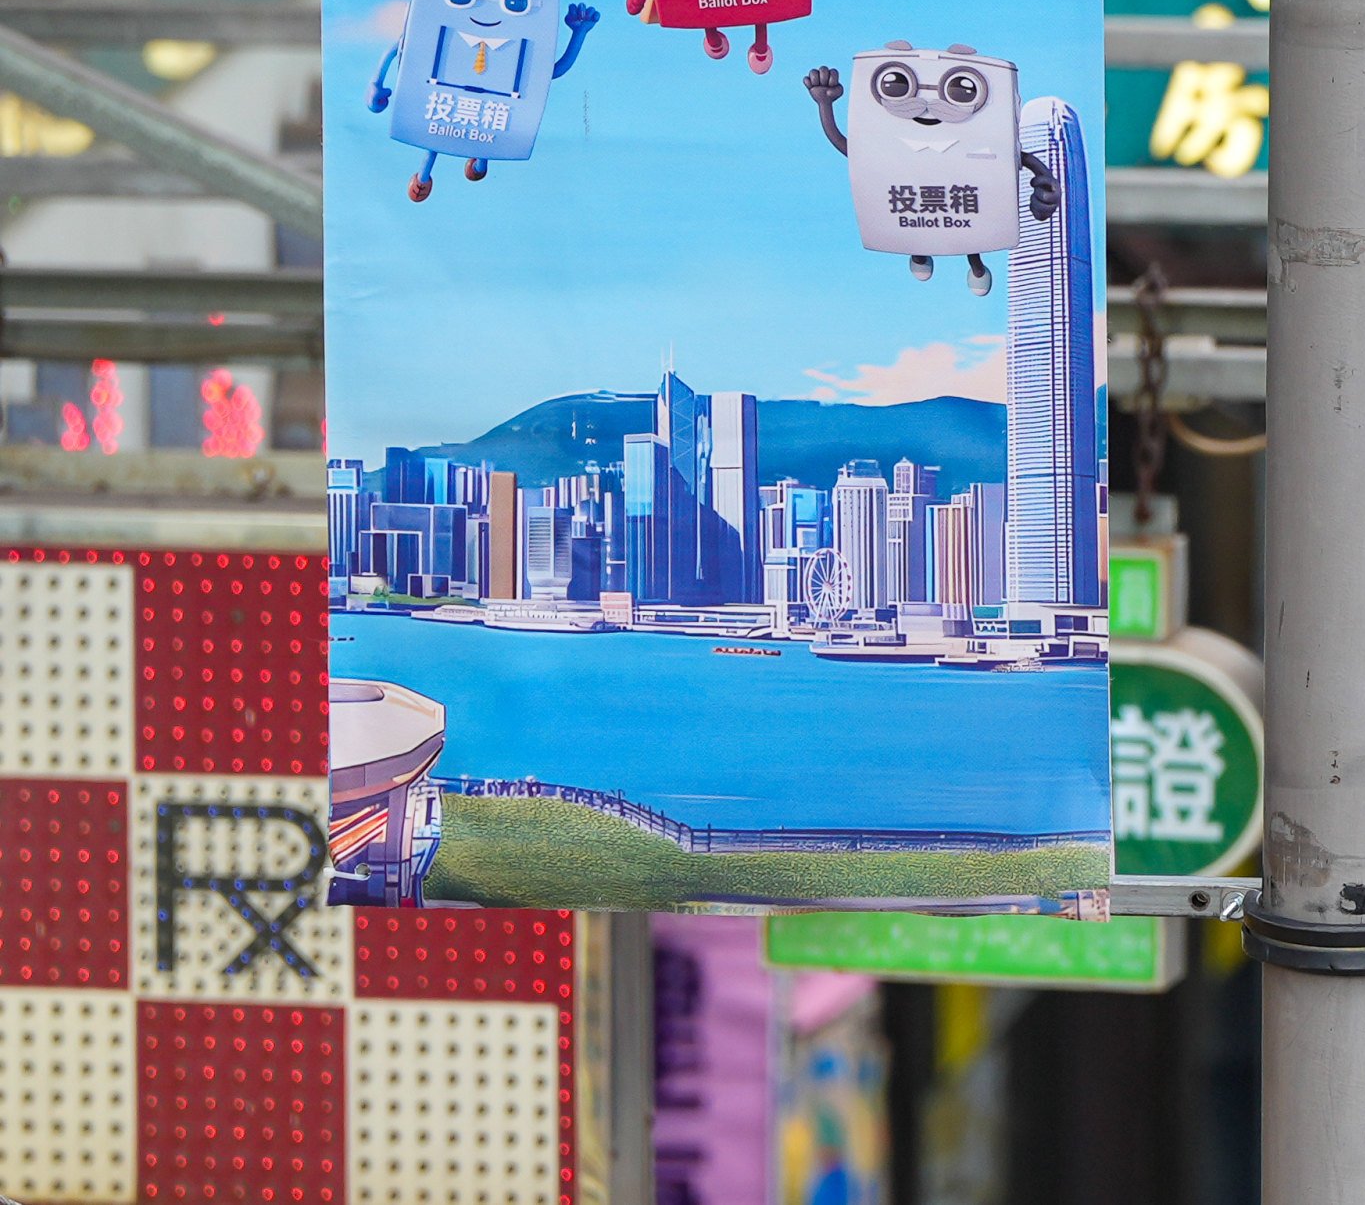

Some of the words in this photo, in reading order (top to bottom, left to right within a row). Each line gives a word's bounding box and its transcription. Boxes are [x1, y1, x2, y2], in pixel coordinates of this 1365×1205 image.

[424, 91, 511, 131] 投票箱
[428, 122, 466, 139] Ballot
[468, 129, 495, 143] Box
[888, 184, 980, 214] 投票箱
[898, 216, 941, 228] Ballot
[942, 216, 972, 228] Box
